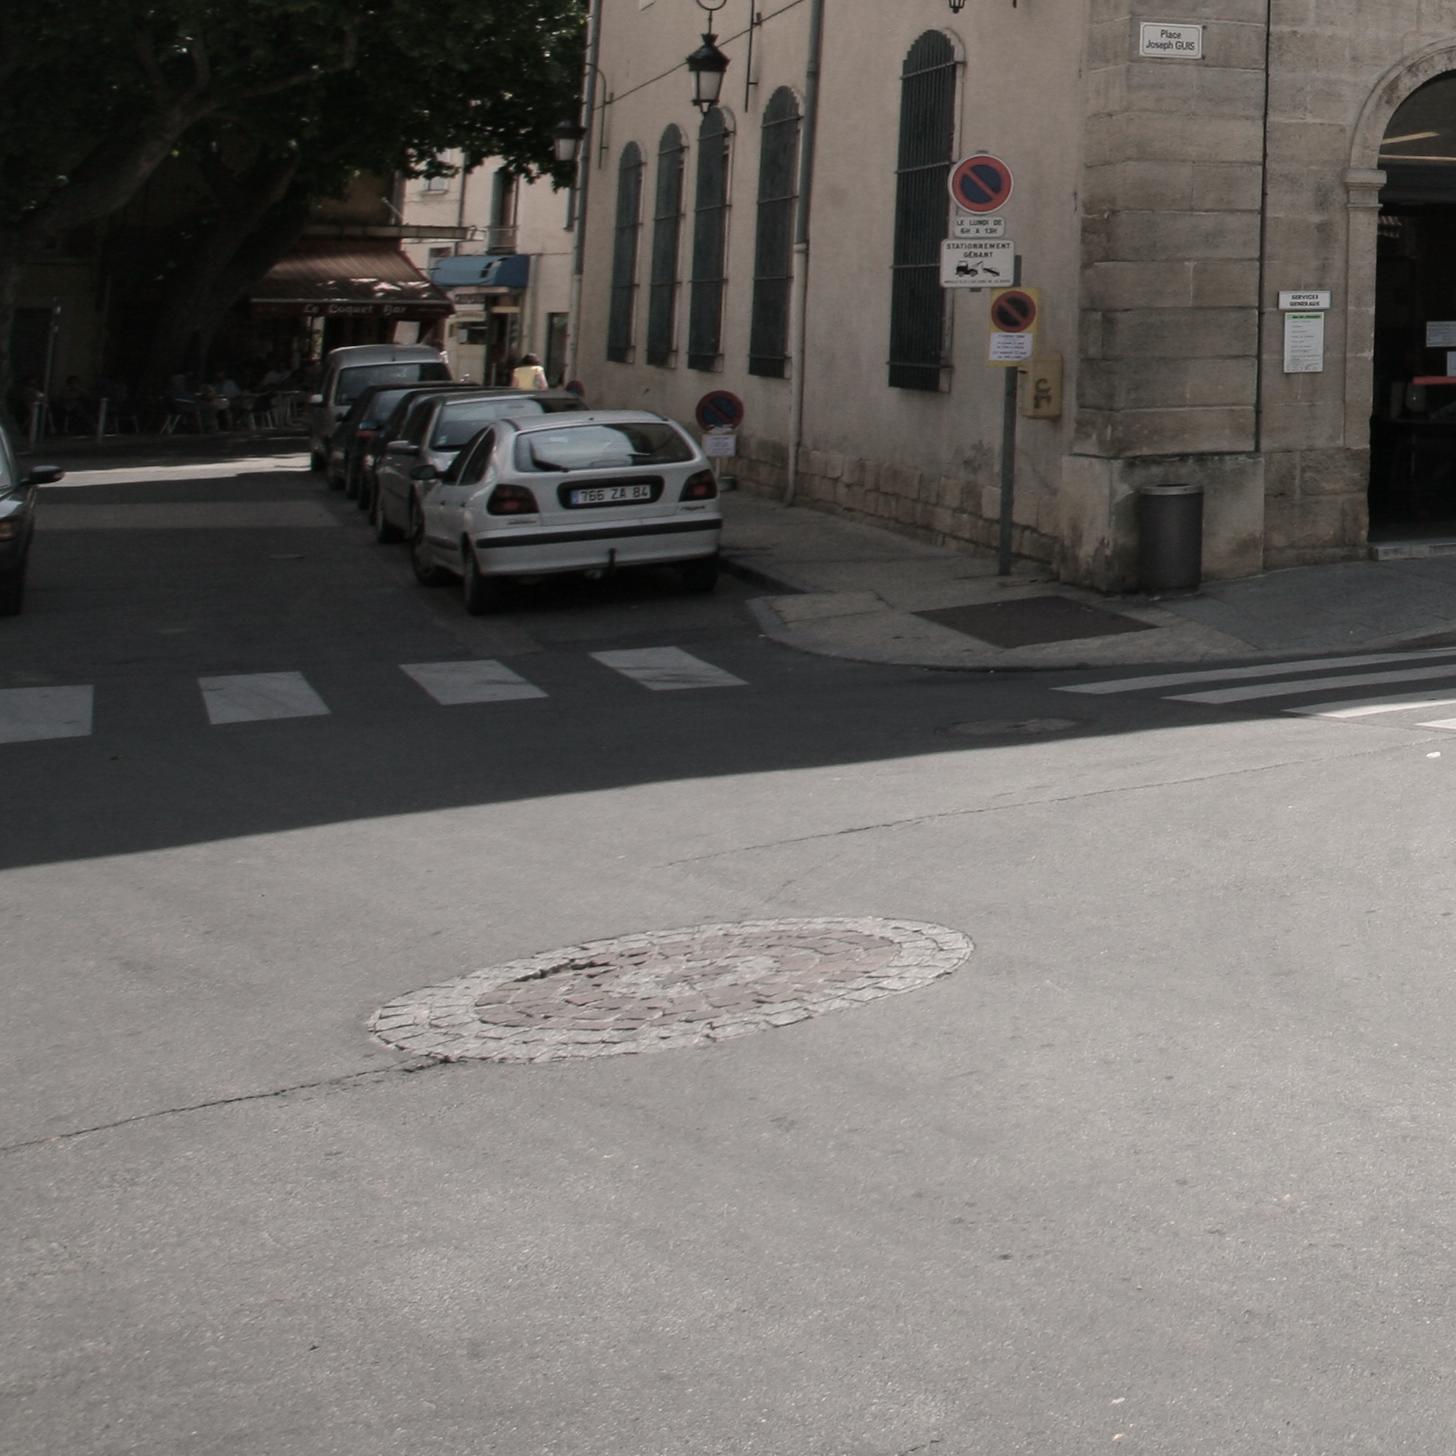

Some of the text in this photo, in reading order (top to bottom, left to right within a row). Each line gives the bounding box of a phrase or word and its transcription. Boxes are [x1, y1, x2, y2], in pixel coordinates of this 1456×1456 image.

[1160, 29, 1181, 39] Place
[1146, 40, 1173, 51] Joseph
[632, 485, 649, 499] 84
